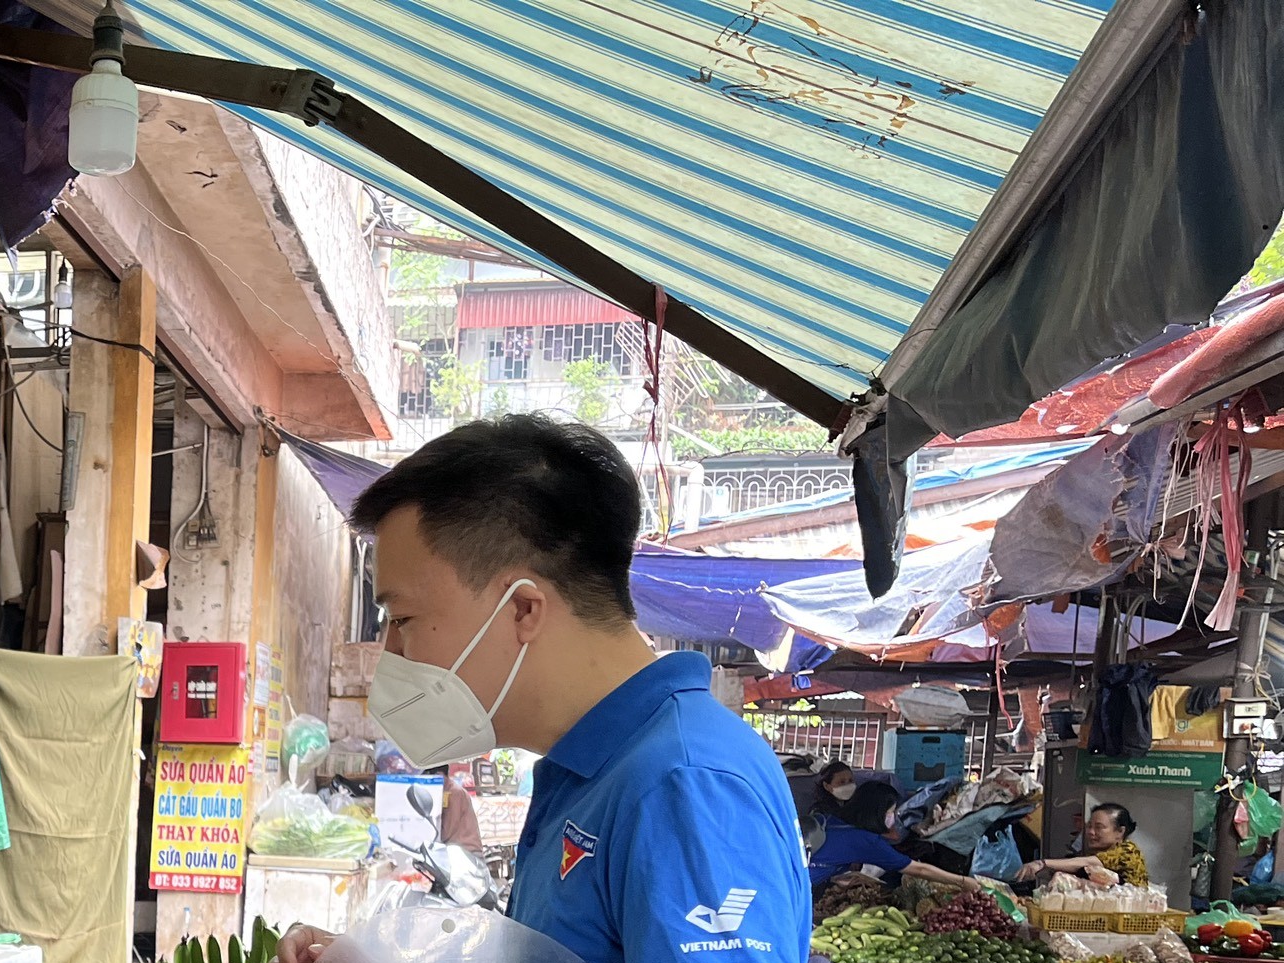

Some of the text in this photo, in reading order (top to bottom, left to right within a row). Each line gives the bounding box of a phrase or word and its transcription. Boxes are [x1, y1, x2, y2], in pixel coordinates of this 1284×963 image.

[160, 755, 185, 782] SỬA
[228, 757, 246, 784] ÁO
[1127, 764, 1157, 776] Xuân
[1157, 765, 1191, 777] Thanh
[157, 822, 240, 844] THAY KHÓA
[158, 845, 182, 867] SỬA
[221, 850, 237, 870] ÁO
[171, 874, 191, 888] 033
[679, 938, 773, 954] VIETNAM POST
